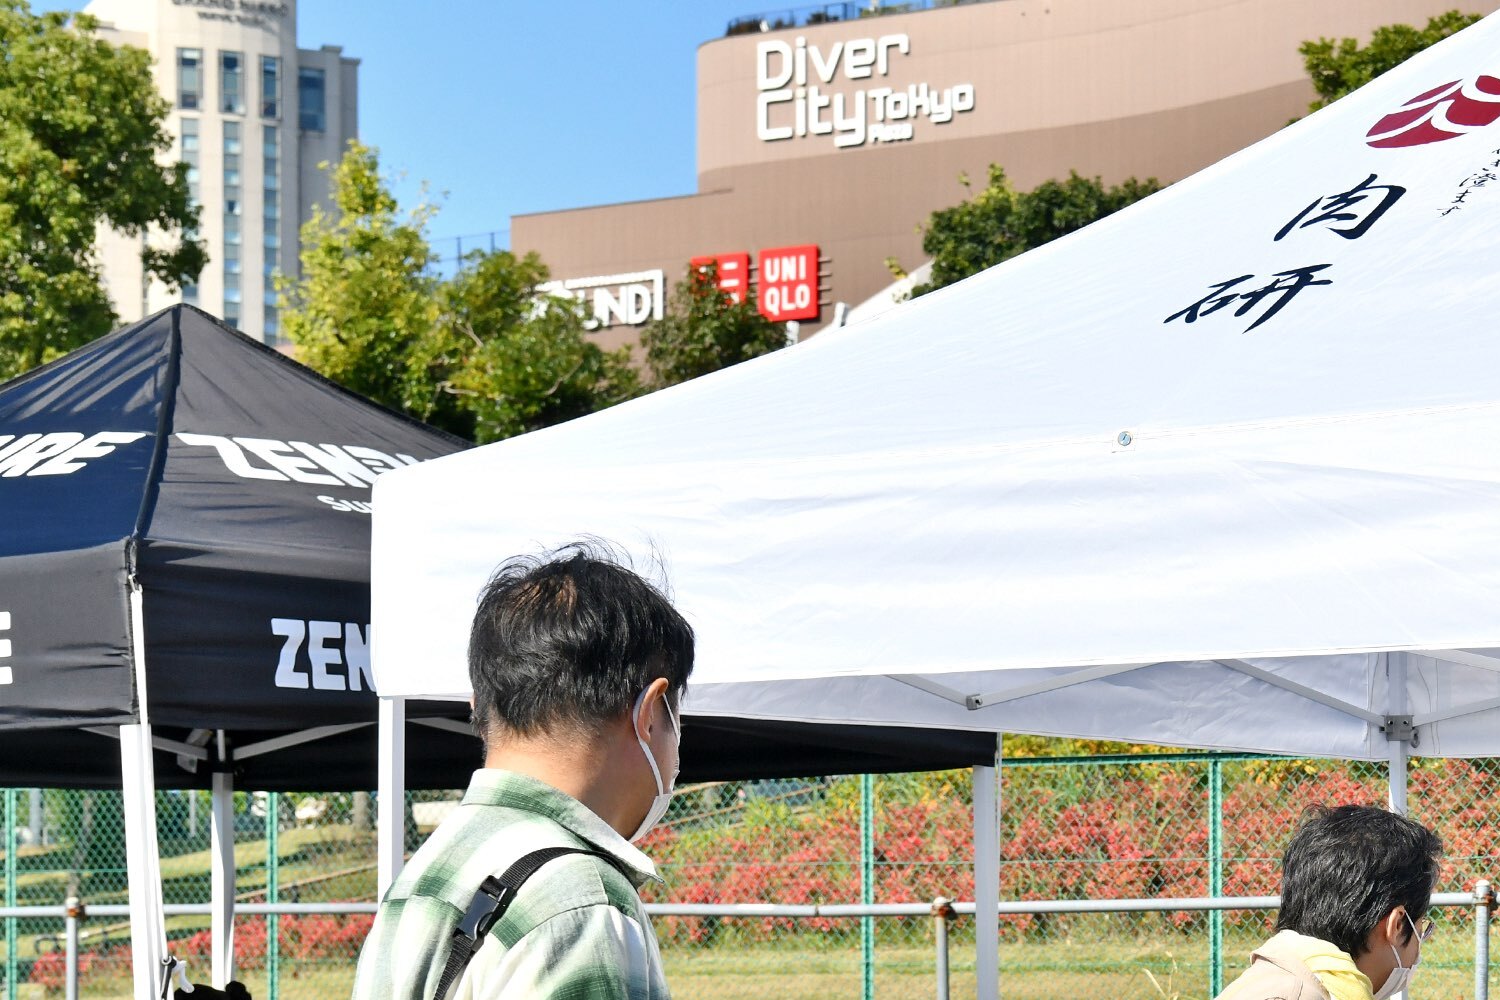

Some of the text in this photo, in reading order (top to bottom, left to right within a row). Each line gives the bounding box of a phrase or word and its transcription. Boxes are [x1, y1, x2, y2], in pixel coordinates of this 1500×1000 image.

[757, 34, 910, 91] Diver
[757, 86, 867, 147] City
[764, 255, 806, 283] UNI
[764, 284, 811, 316] QLO
[175, 433, 426, 488] ZEND
